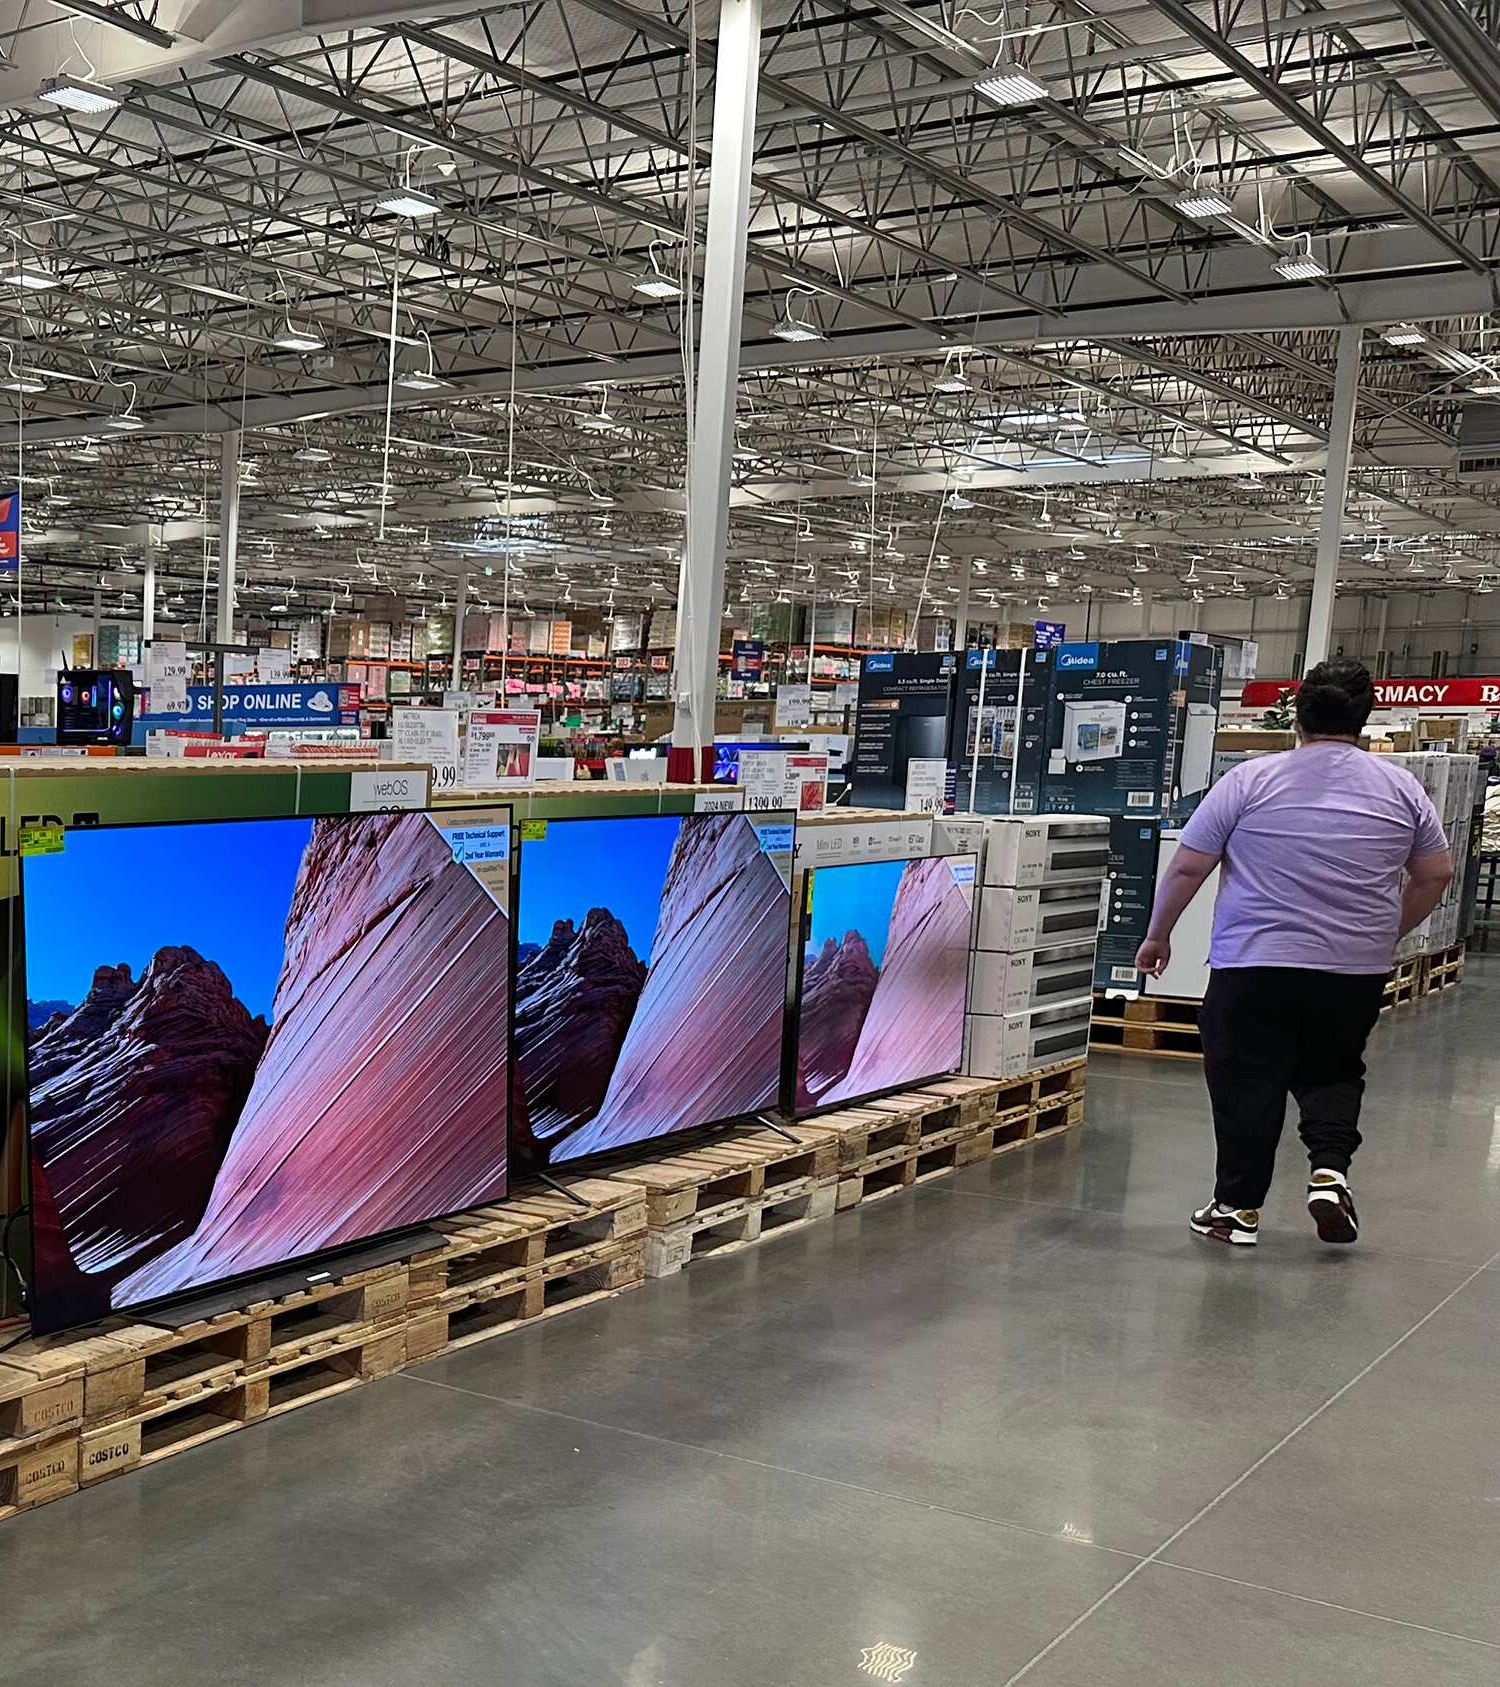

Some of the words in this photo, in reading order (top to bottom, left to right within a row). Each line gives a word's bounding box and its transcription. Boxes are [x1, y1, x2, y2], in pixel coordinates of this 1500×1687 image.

[1065, 655, 1095, 666] Midea
[163, 665, 186, 677] 129.99
[919, 677, 936, 685] Single
[1107, 677, 1140, 686] FREEZER
[244, 693, 302, 711] ONLINE
[373, 779, 409, 796] webOS
[720, 801, 734, 810] NEW
[452, 831, 464, 841] FREE
[466, 830, 486, 840] Technical
[487, 829, 506, 839] Support
[1025, 829, 1041, 838] SONY
[816, 839, 829, 851] Mini
[831, 838, 842, 850] LED
[485, 849, 505, 859] Warranty
[1017, 895, 1033, 904] SONY
[1011, 958, 1026, 967] SONY
[1008, 1021, 1024, 1030] SONY
[34, 1400, 74, 1422] COSTCO
[89, 1442, 129, 1465] COSTCO
[27, 1460, 65, 1485] COSTCO
